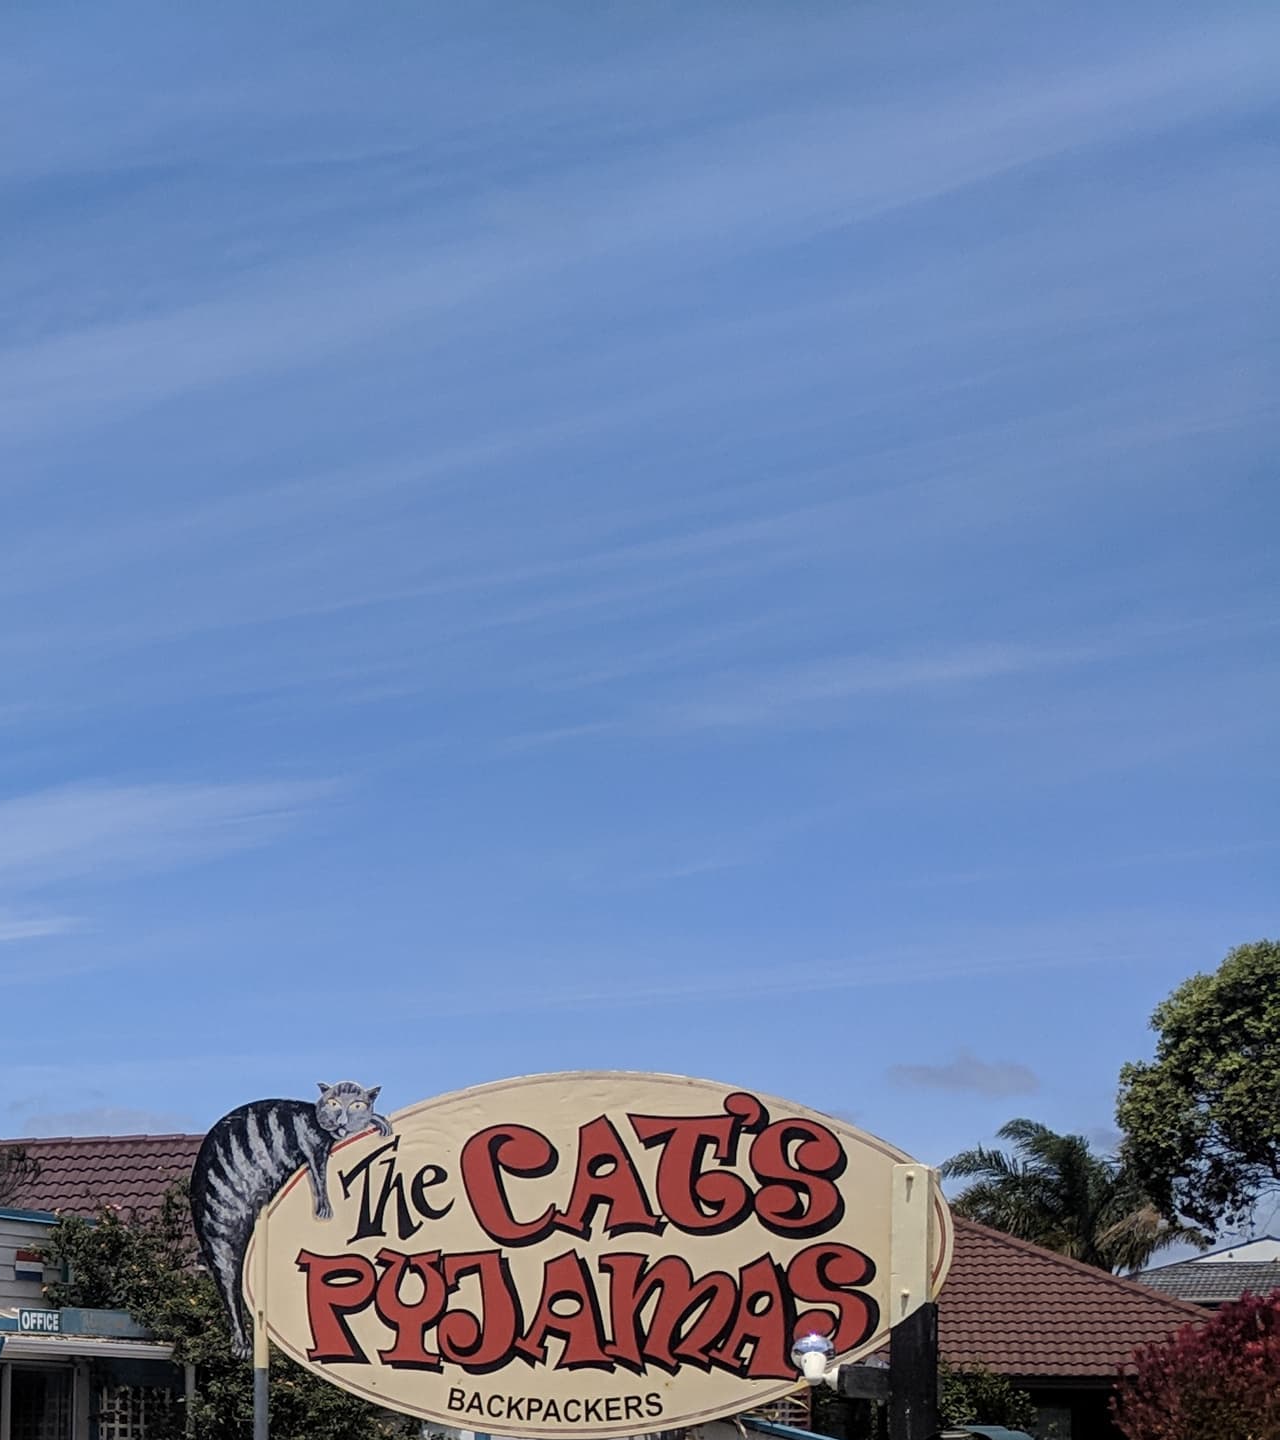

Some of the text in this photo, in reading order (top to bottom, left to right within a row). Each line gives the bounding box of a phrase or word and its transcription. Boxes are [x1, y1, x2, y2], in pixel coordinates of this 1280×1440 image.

[338, 1092, 847, 1247] The CAT'S
[21, 1311, 59, 1331] OFFICE
[296, 1242, 880, 1380] PYJAMAS
[447, 1387, 663, 1423] BACKPACKERS
